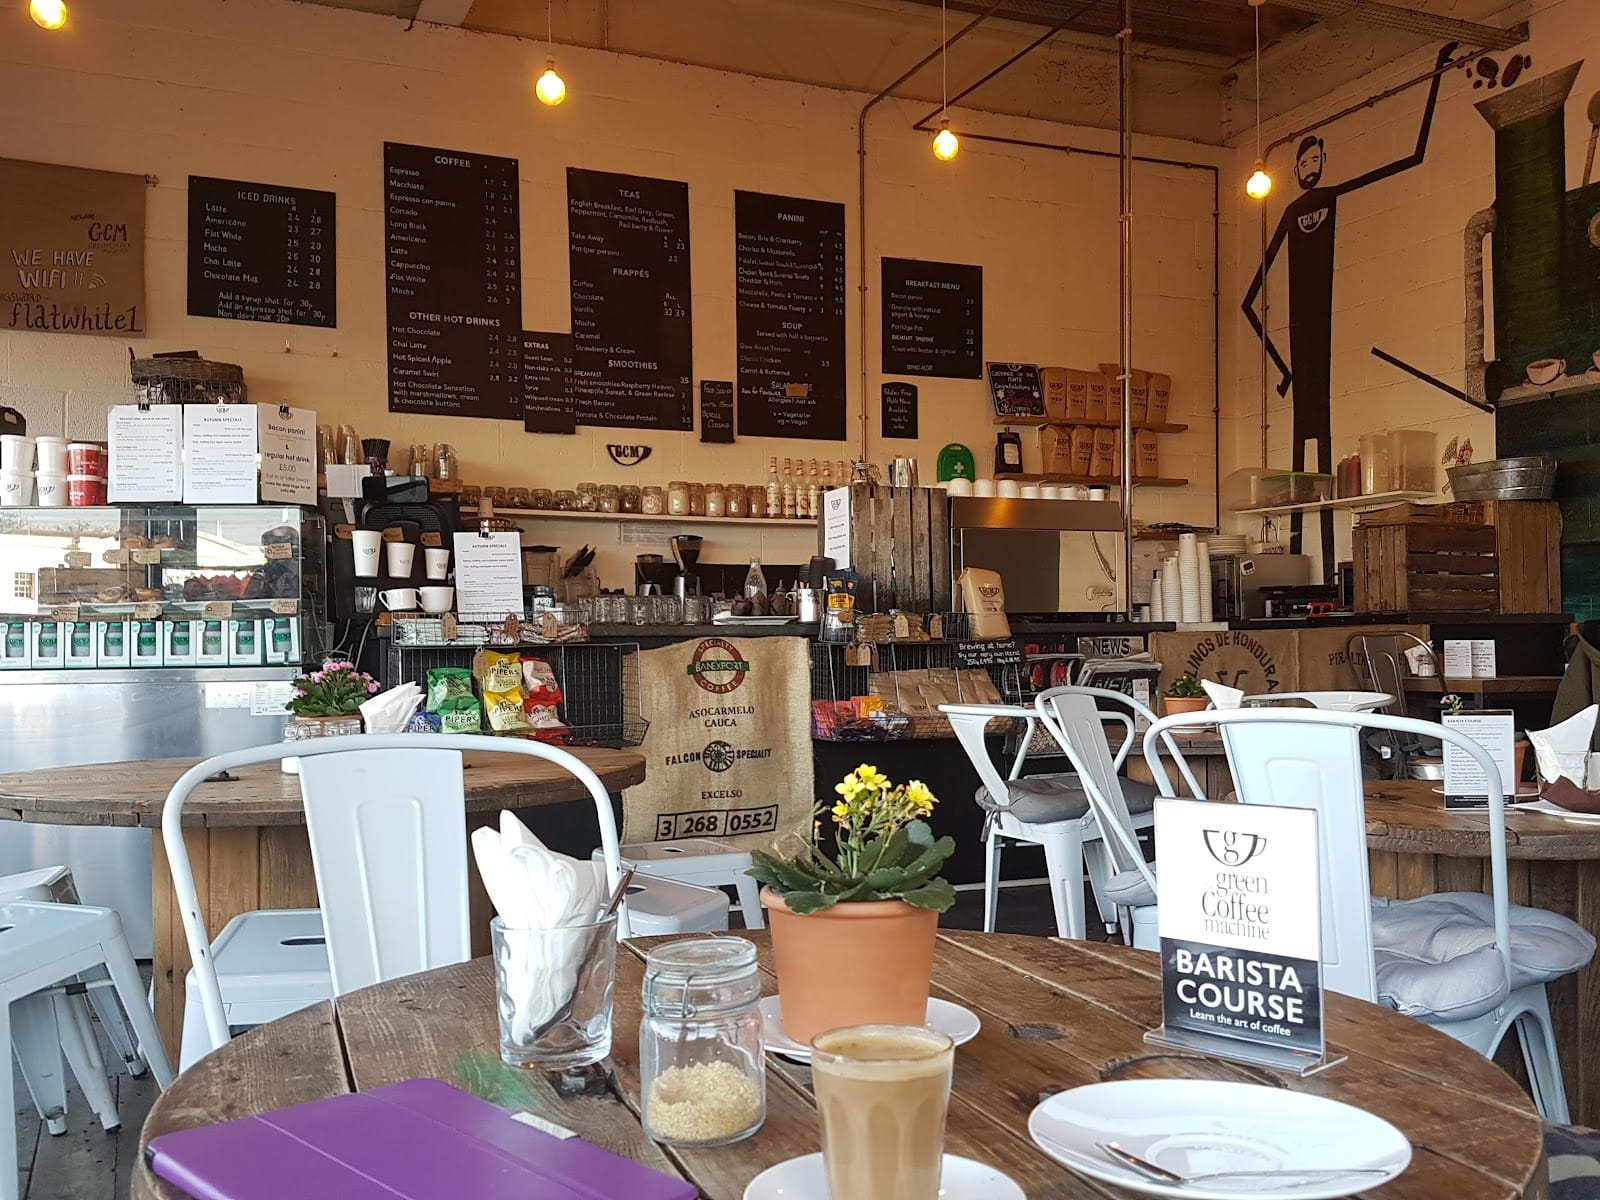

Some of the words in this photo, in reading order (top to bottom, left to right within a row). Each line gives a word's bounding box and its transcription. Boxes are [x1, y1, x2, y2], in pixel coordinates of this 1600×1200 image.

[434, 156, 471, 168] COFFEE
[390, 166, 420, 177] Espresso
[390, 180, 424, 190] Macchiato
[238, 192, 259, 201] ICED
[263, 194, 296, 205] DRINKS
[390, 193, 420, 202] Espresso
[619, 189, 640, 199] TEAS
[205, 203, 226, 213] Latte
[205, 215, 246, 227] Americano
[778, 213, 804, 222] PANINI
[1303, 209, 1319, 226] GCM
[390, 221, 407, 229] Long
[409, 222, 427, 230] Black
[88, 223, 127, 241] GCM
[205, 229, 219, 238] Flat
[222, 231, 242, 241] White
[391, 234, 426, 243] Americano
[204, 242, 227, 253] Mocha
[12, 250, 41, 266] WE
[53, 250, 94, 266] HAVE
[204, 257, 219, 265] Chai
[223, 258, 241, 267] Latte
[391, 260, 430, 271] Cappuccino
[17, 269, 66, 289] WIFI
[204, 270, 240, 282] Chocolate
[243, 275, 258, 284] Milk
[905, 280, 940, 289] BREAKFAST
[941, 282, 960, 290] MENU
[219, 292, 232, 300] Add
[242, 296, 262, 305] syrup
[265, 297, 279, 305] shot
[218, 301, 232, 309] Add
[245, 304, 275, 314] espresso
[278, 307, 293, 315] shot
[9, 302, 142, 332] flatwhite1
[409, 311, 440, 321] OTHER
[444, 315, 463, 323] HOT
[466, 317, 500, 327] DRINKS
[407, 327, 440, 336] Chocolate
[782, 322, 803, 330] SOUP
[524, 341, 549, 350] EXTRAS
[408, 355, 430, 363] Spiced
[432, 356, 452, 365] Apple
[608, 360, 658, 370] SMOOTHIES
[408, 382, 442, 390] Chocolate
[268, 424, 286, 432] Bacon
[265, 452, 284, 460] regular
[616, 446, 639, 457] GCM
[280, 464, 296, 472] £5.00
[959, 643, 985, 651] Brewing
[1092, 638, 1131, 657] NEWS
[695, 661, 744, 672] BANEXPORT
[1216, 633, 1230, 647] DE
[1233, 632, 1279, 691] HONDURA
[700, 680, 738, 693] COFFEE
[688, 706, 755, 719] ASOCARMELO
[704, 718, 737, 728] CAUCA
[665, 751, 701, 766] FALCON
[736, 749, 772, 759] SPECIALTY
[701, 790, 743, 800] EXCELSO
[660, 820, 672, 836] 3
[683, 815, 718, 834] 268
[730, 810, 773, 831] 0552
[1216, 871, 1268, 896] green
[1201, 890, 1269, 924] Coffee
[1205, 917, 1270, 941] machine
[1176, 948, 1303, 994] BARISTA
[1176, 978, 1304, 1024] COURSE
[1189, 1008, 1215, 1022] Learn
[1217, 1013, 1232, 1025] the
[1234, 1017, 1249, 1030] art
[1250, 1020, 1260, 1030] of
[1262, 1022, 1291, 1037] coffee
